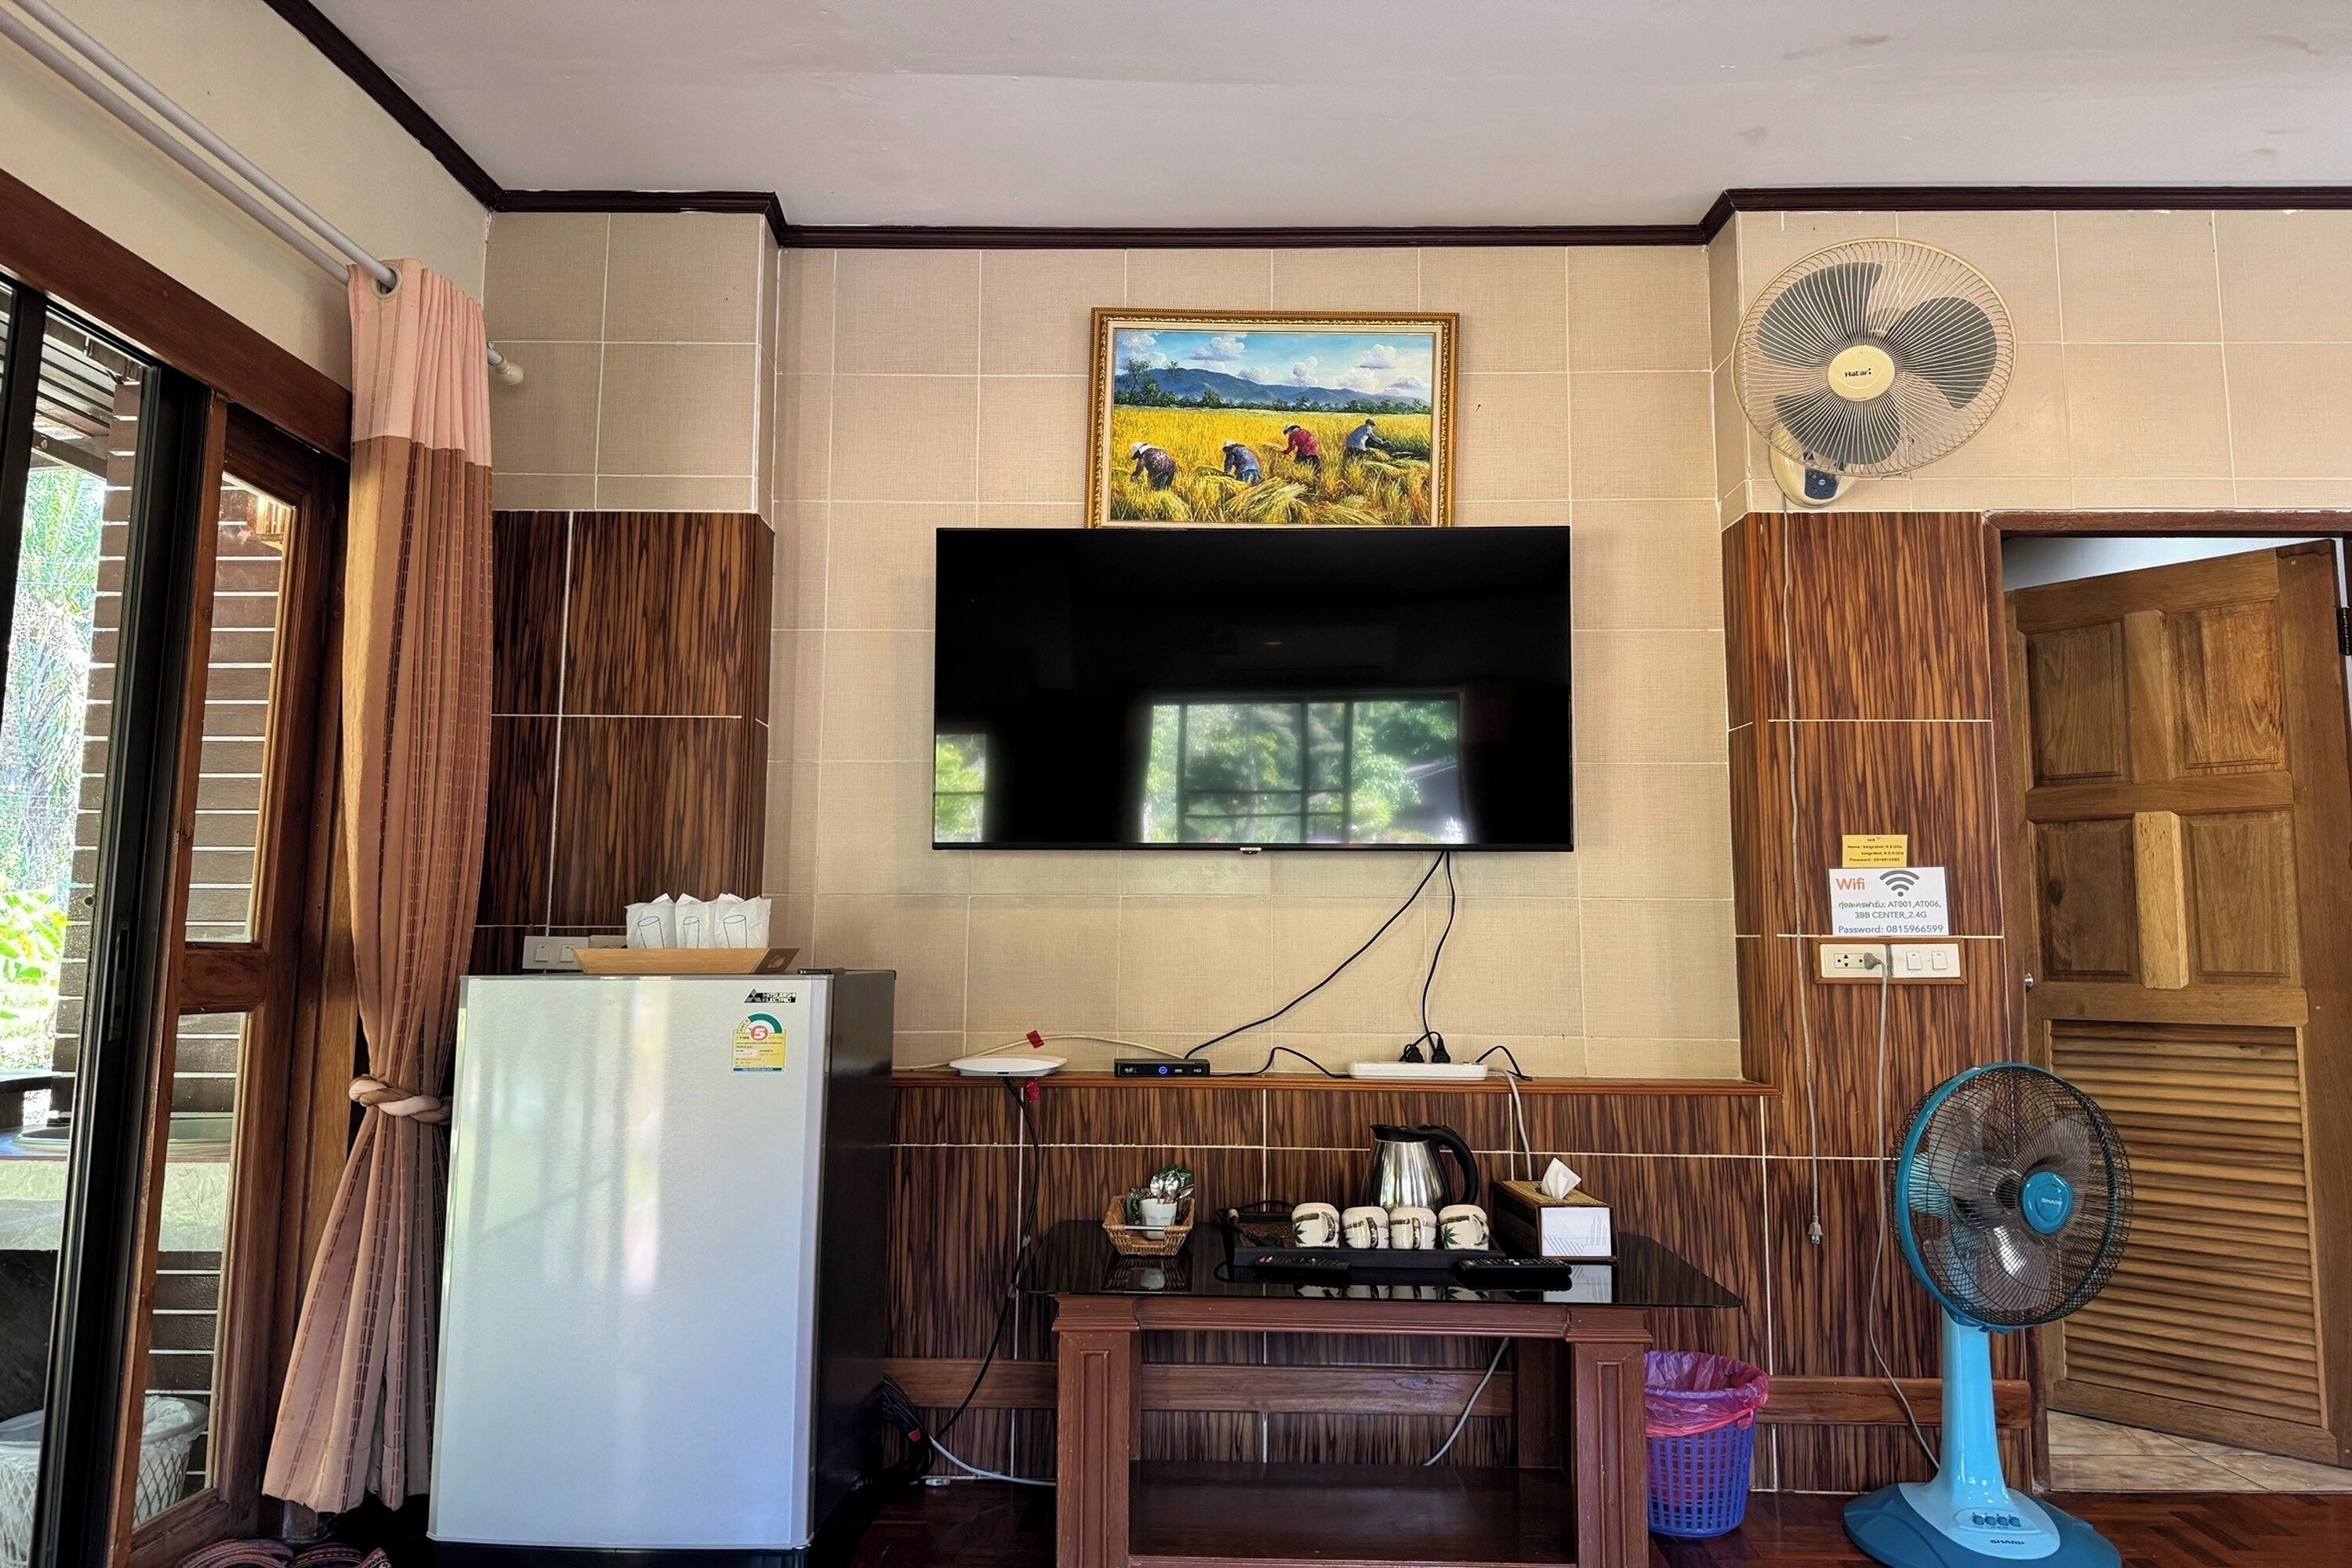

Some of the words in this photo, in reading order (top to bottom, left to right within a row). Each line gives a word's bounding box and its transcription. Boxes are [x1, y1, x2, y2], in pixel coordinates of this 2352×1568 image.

[1845, 368, 1871, 377] Hatari
[1835, 877, 1865, 891] Wifi
[1838, 925, 1884, 935] Password:
[1886, 924, 1944, 933] 0815966599
[753, 1027, 765, 1039] 5
